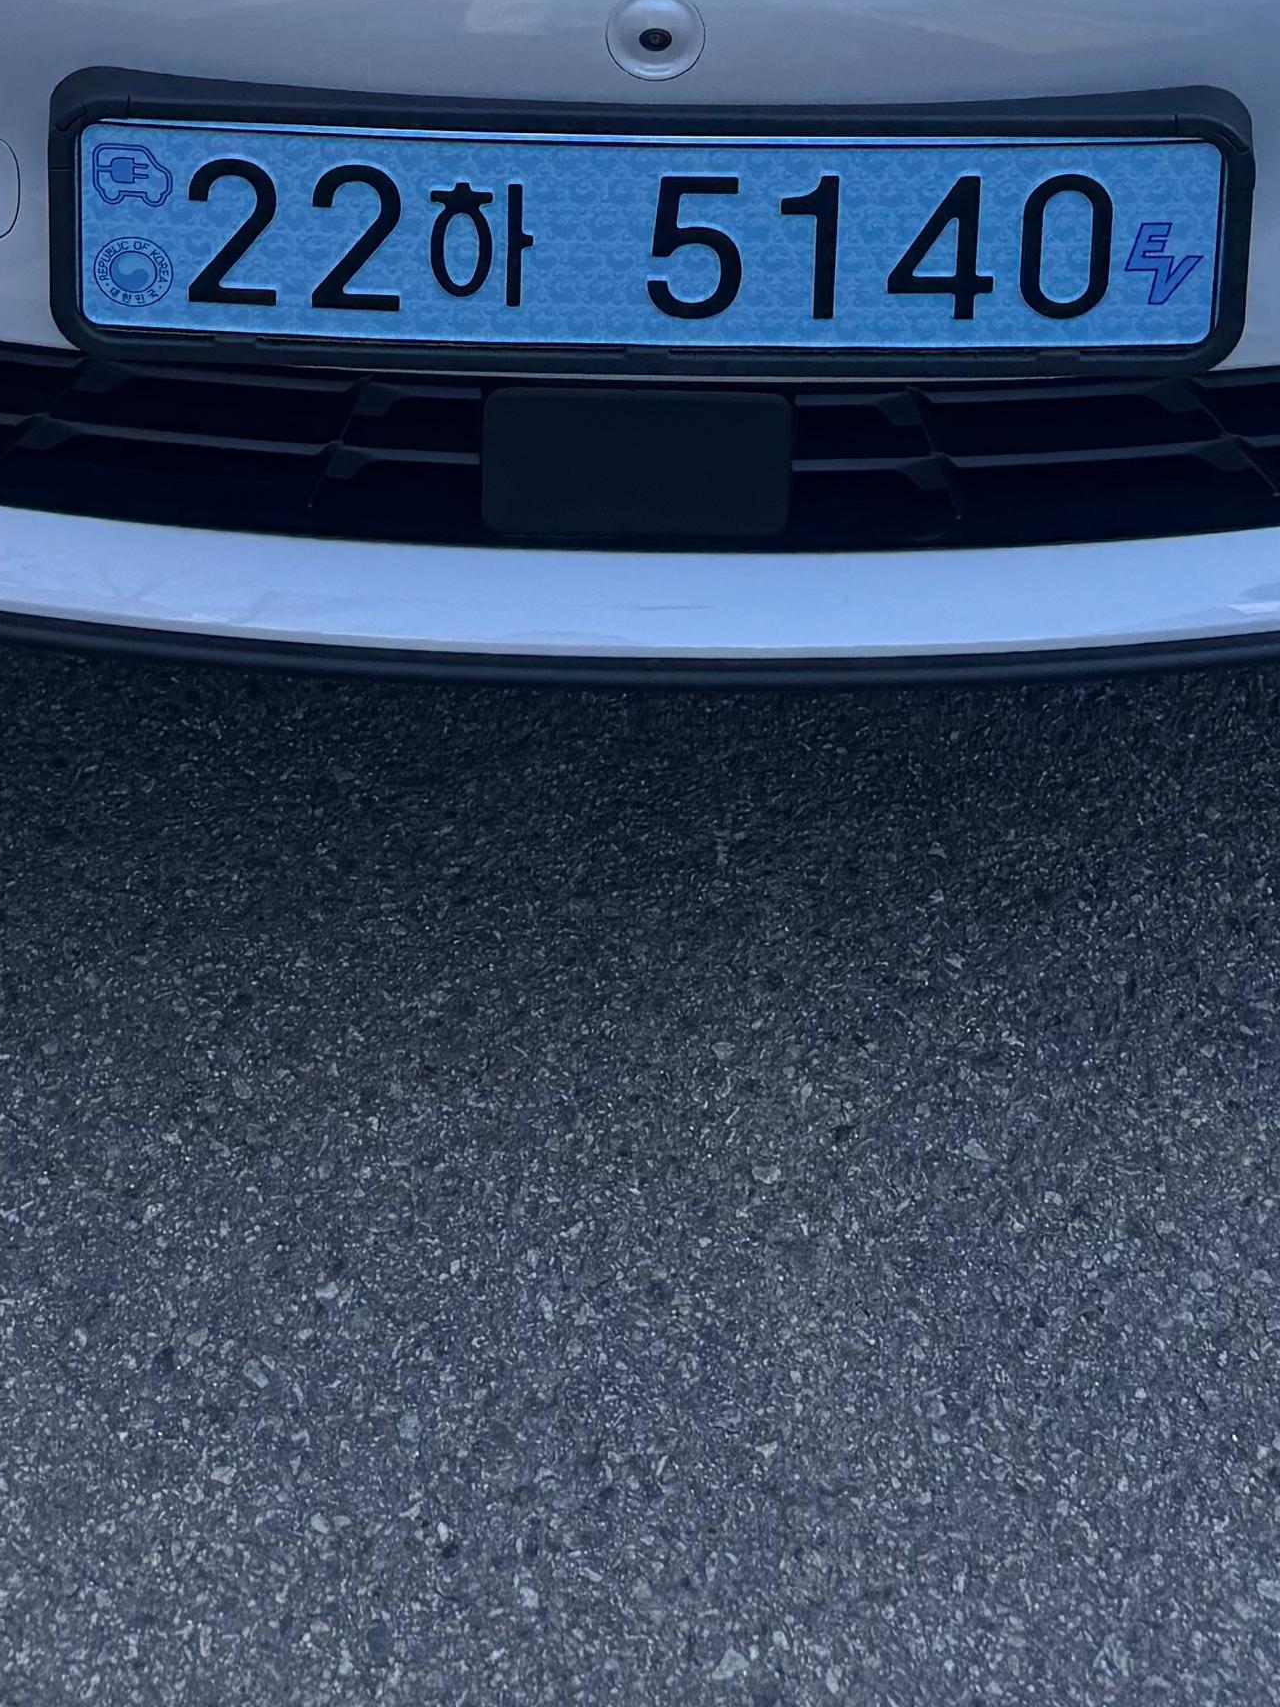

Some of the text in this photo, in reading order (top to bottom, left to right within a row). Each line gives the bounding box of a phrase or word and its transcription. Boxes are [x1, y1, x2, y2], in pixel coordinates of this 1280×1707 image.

[133, 241, 150, 250] OF
[149, 249, 169, 283] KOREA
[186, 159, 1111, 321] 22하 5140
[1124, 222, 1204, 305] EV
